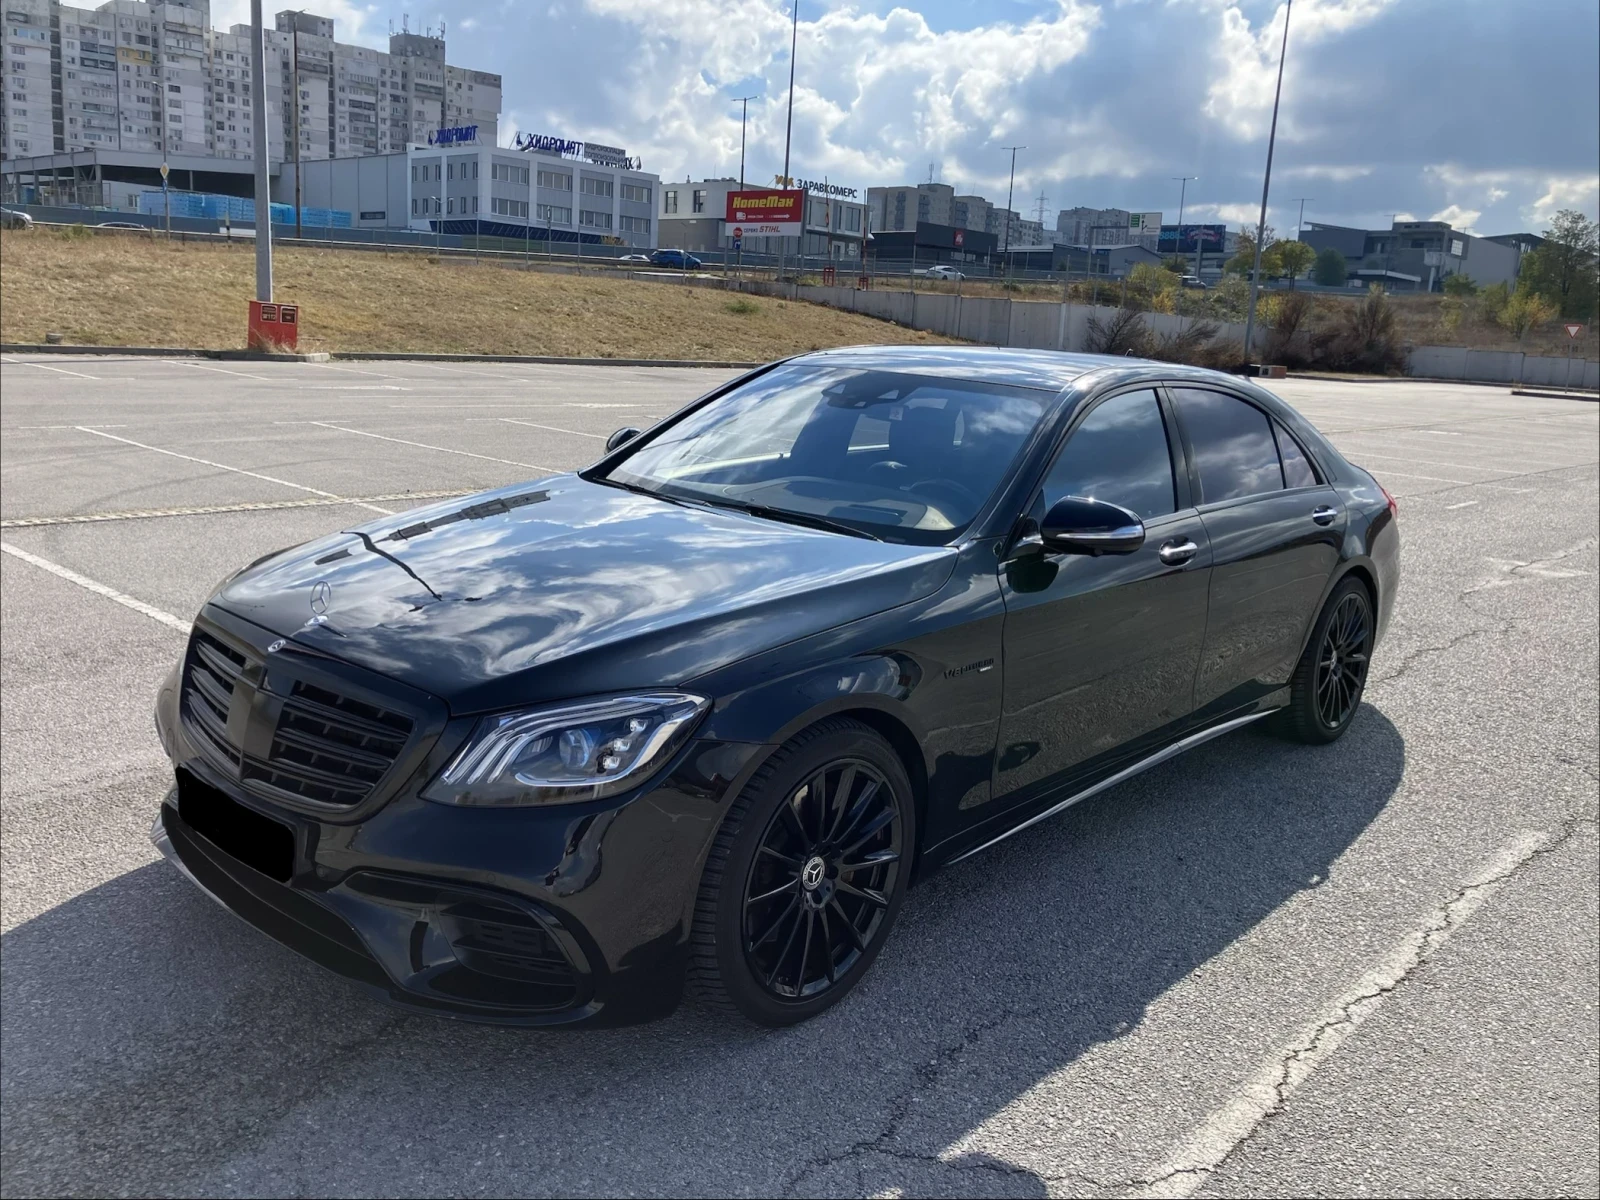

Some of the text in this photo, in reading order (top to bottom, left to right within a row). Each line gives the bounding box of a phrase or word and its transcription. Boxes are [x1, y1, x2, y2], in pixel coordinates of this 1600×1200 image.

[434, 125, 478, 144] ХИДРОМАТ
[528, 133, 584, 156] ХИДРОМАТ
[797, 178, 858, 199] ЗДРАВКОМЕРС
[732, 195, 794, 209] HomeMax
[759, 225, 781, 233] STIHL
